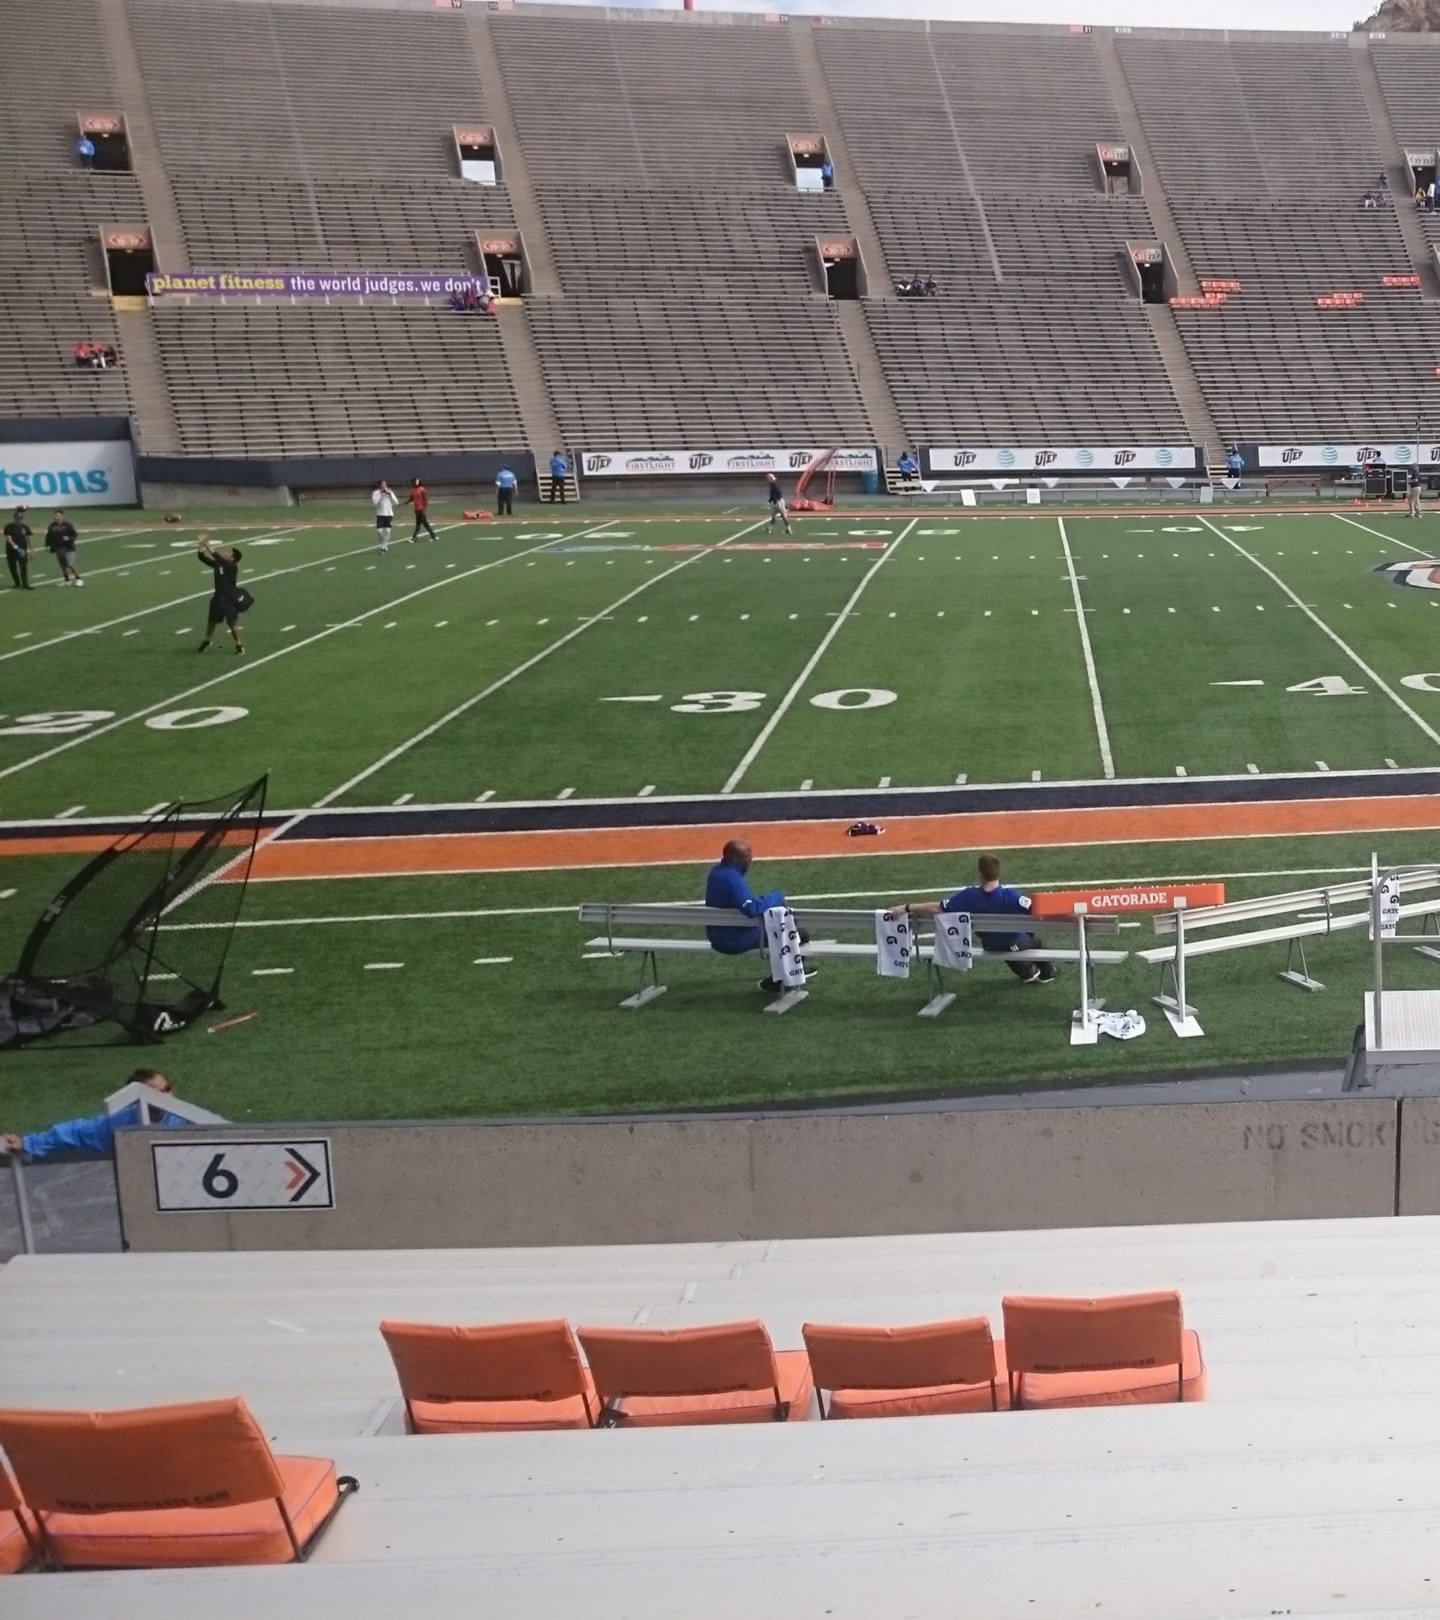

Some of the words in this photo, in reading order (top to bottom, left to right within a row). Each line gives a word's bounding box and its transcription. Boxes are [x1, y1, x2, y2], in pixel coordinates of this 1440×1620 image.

[152, 275, 216, 293] planet
[219, 274, 284, 290] fitness
[290, 276, 315, 290] the
[319, 276, 361, 291] world
[364, 277, 418, 294] judges.
[420, 280, 441, 292] we
[1091, 892, 1167, 908] GATORADE
[1243, 1122, 1286, 1150] NO
[202, 1152, 239, 1199] 6
